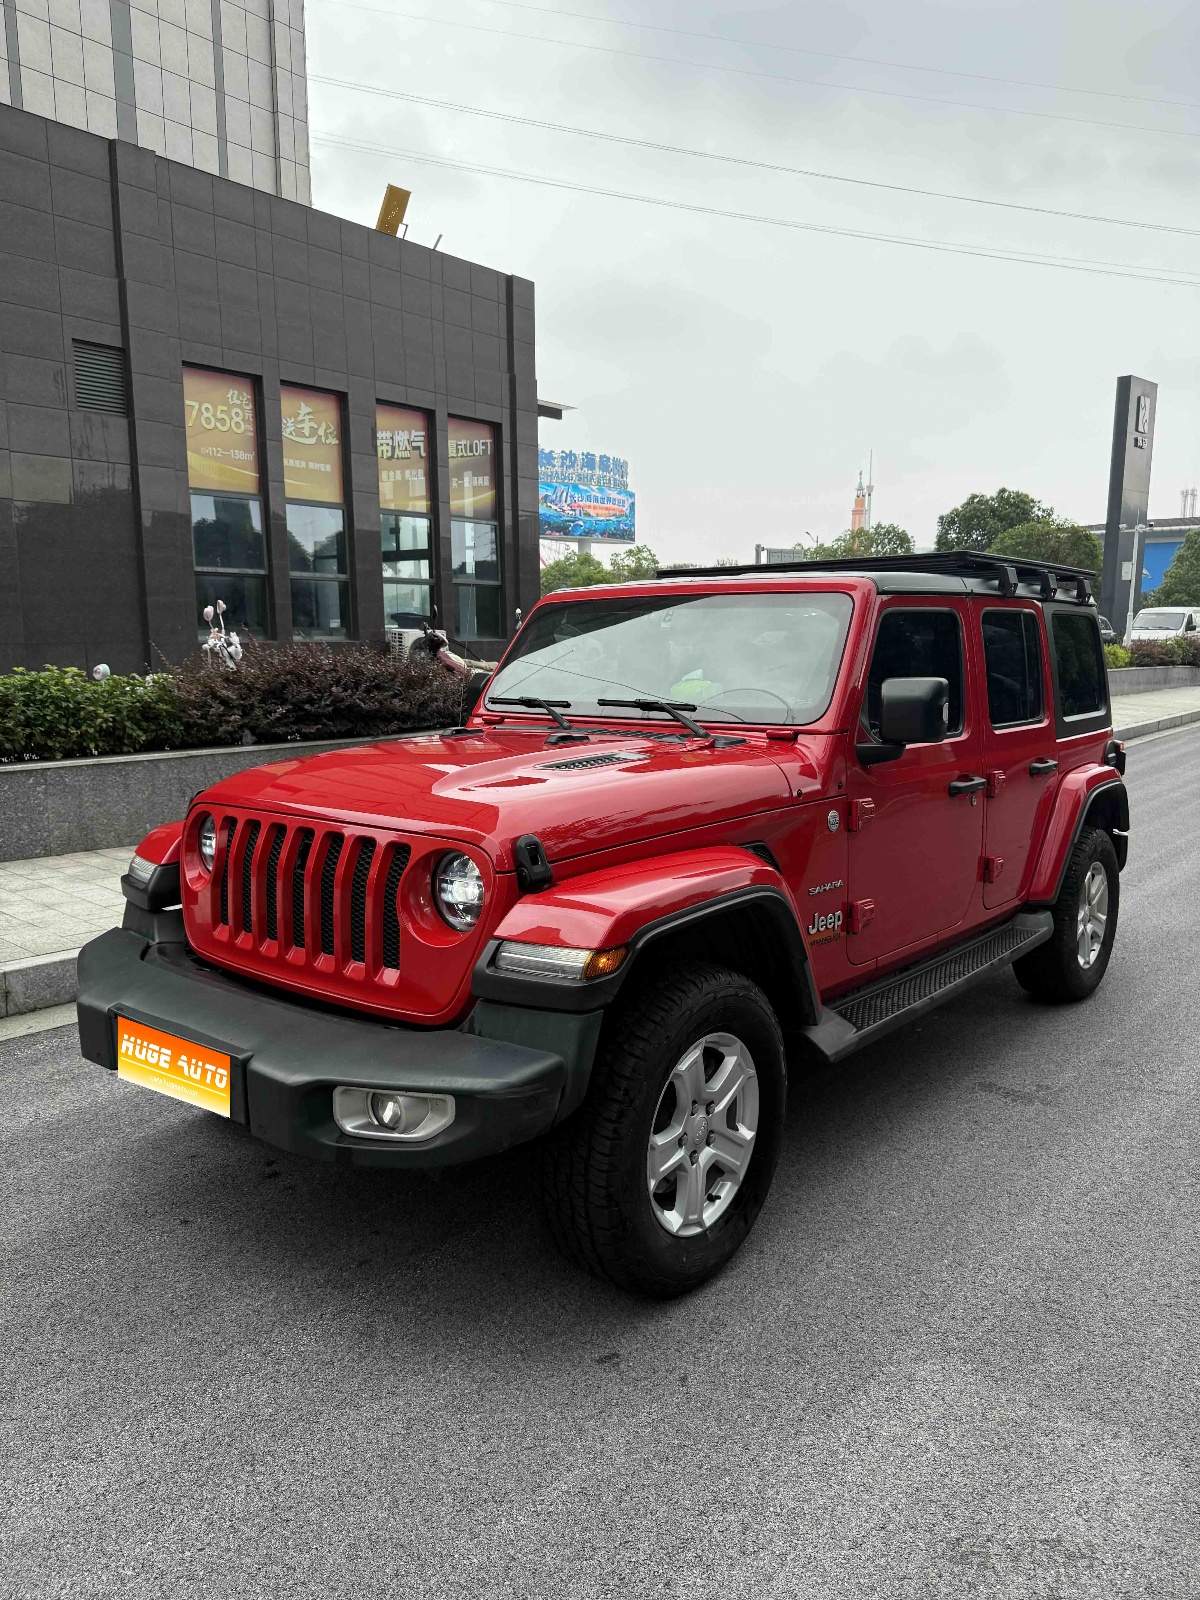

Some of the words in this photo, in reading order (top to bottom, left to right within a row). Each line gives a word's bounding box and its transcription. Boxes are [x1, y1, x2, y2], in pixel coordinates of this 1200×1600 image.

[227, 389, 252, 409] 住宅
[185, 400, 245, 434] 7858
[281, 401, 339, 446] 送车位
[377, 429, 426, 459] 带燃气
[808, 879, 844, 896] SAHARA
[808, 910, 843, 935] Jeep
